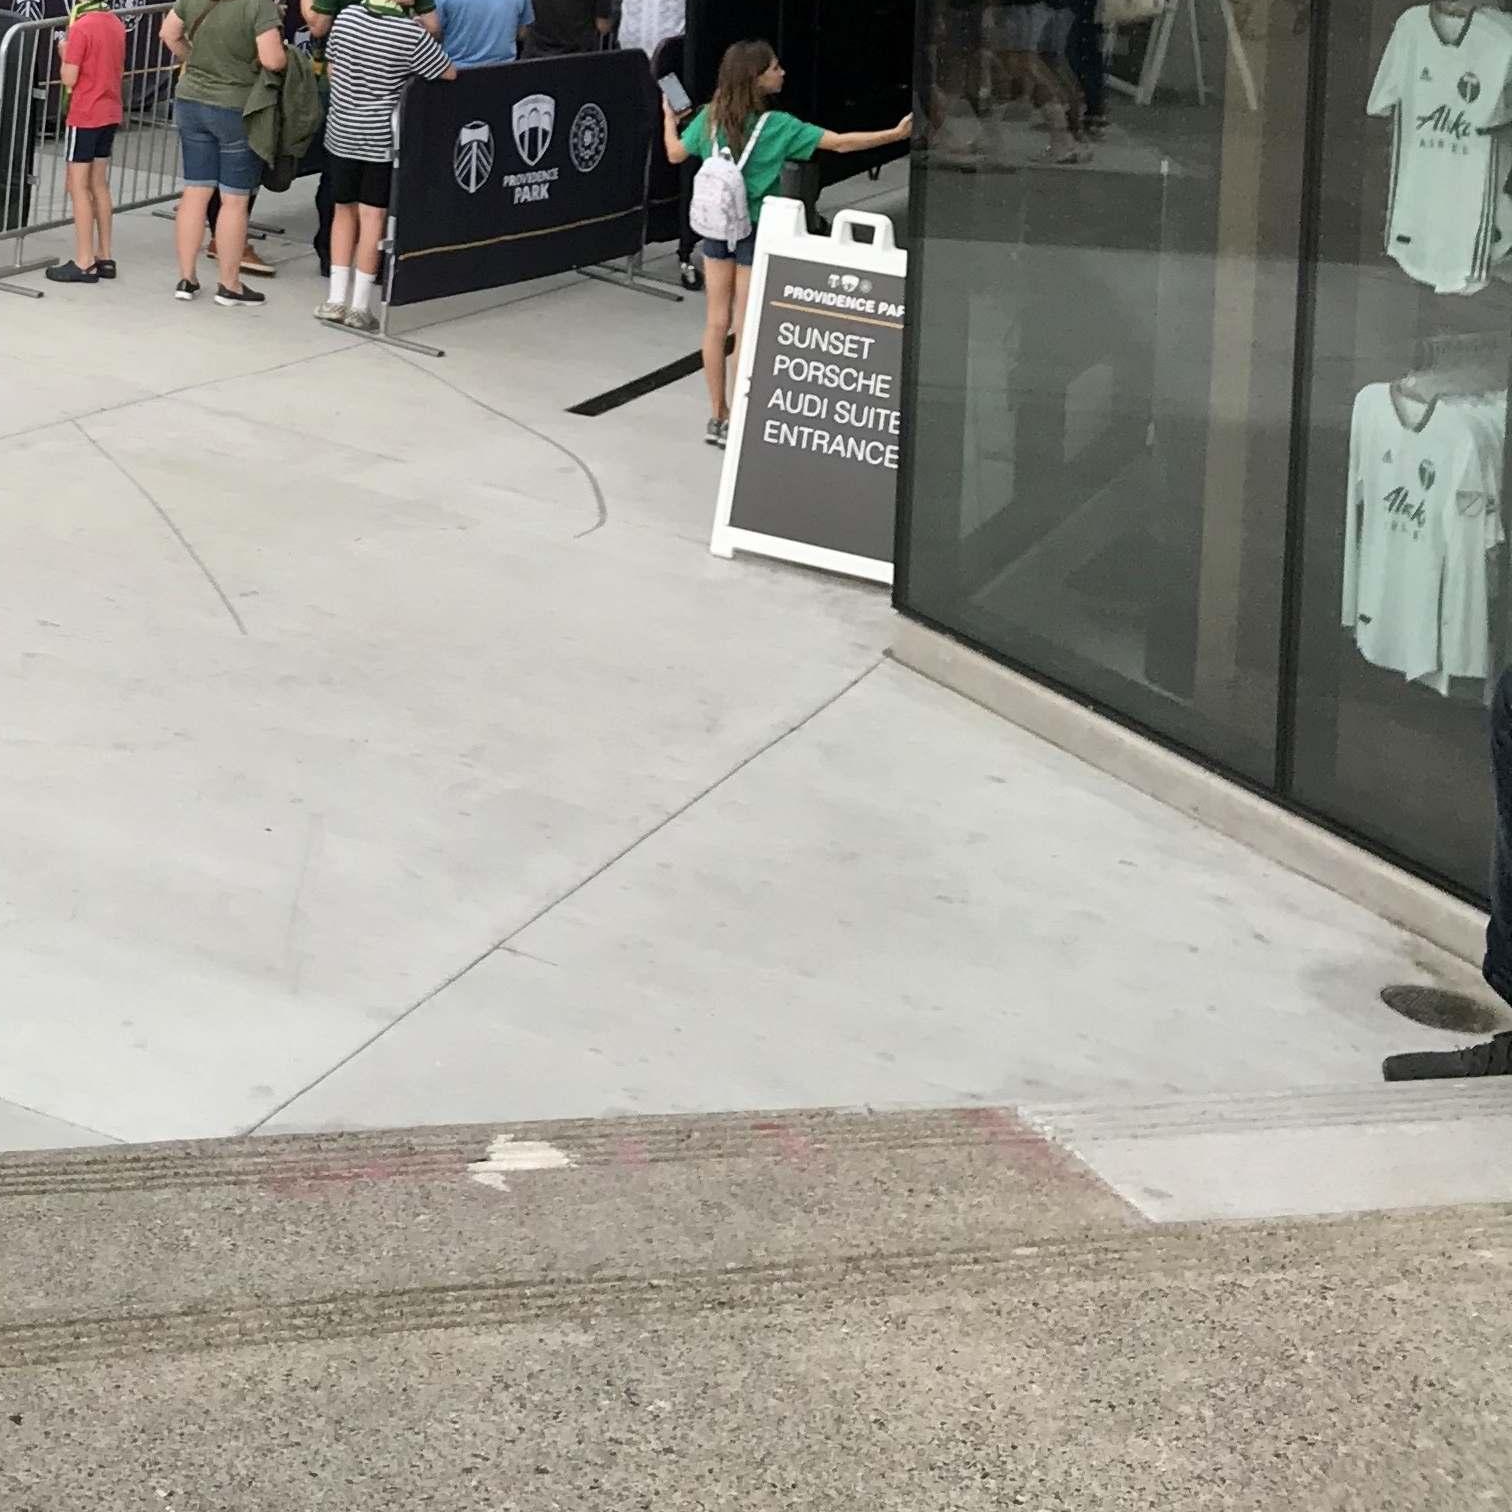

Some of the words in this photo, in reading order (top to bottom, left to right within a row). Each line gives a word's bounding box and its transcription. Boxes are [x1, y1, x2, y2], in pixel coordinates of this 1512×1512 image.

[503, 168, 559, 187] PROVIDENCE
[514, 183, 549, 204] PARK
[784, 285, 875, 312] PROVIDENCE
[777, 322, 875, 359] SUNSET
[773, 354, 892, 398] PORSCHE
[767, 388, 828, 419] AUDI
[764, 419, 899, 469] ENTRANCE
